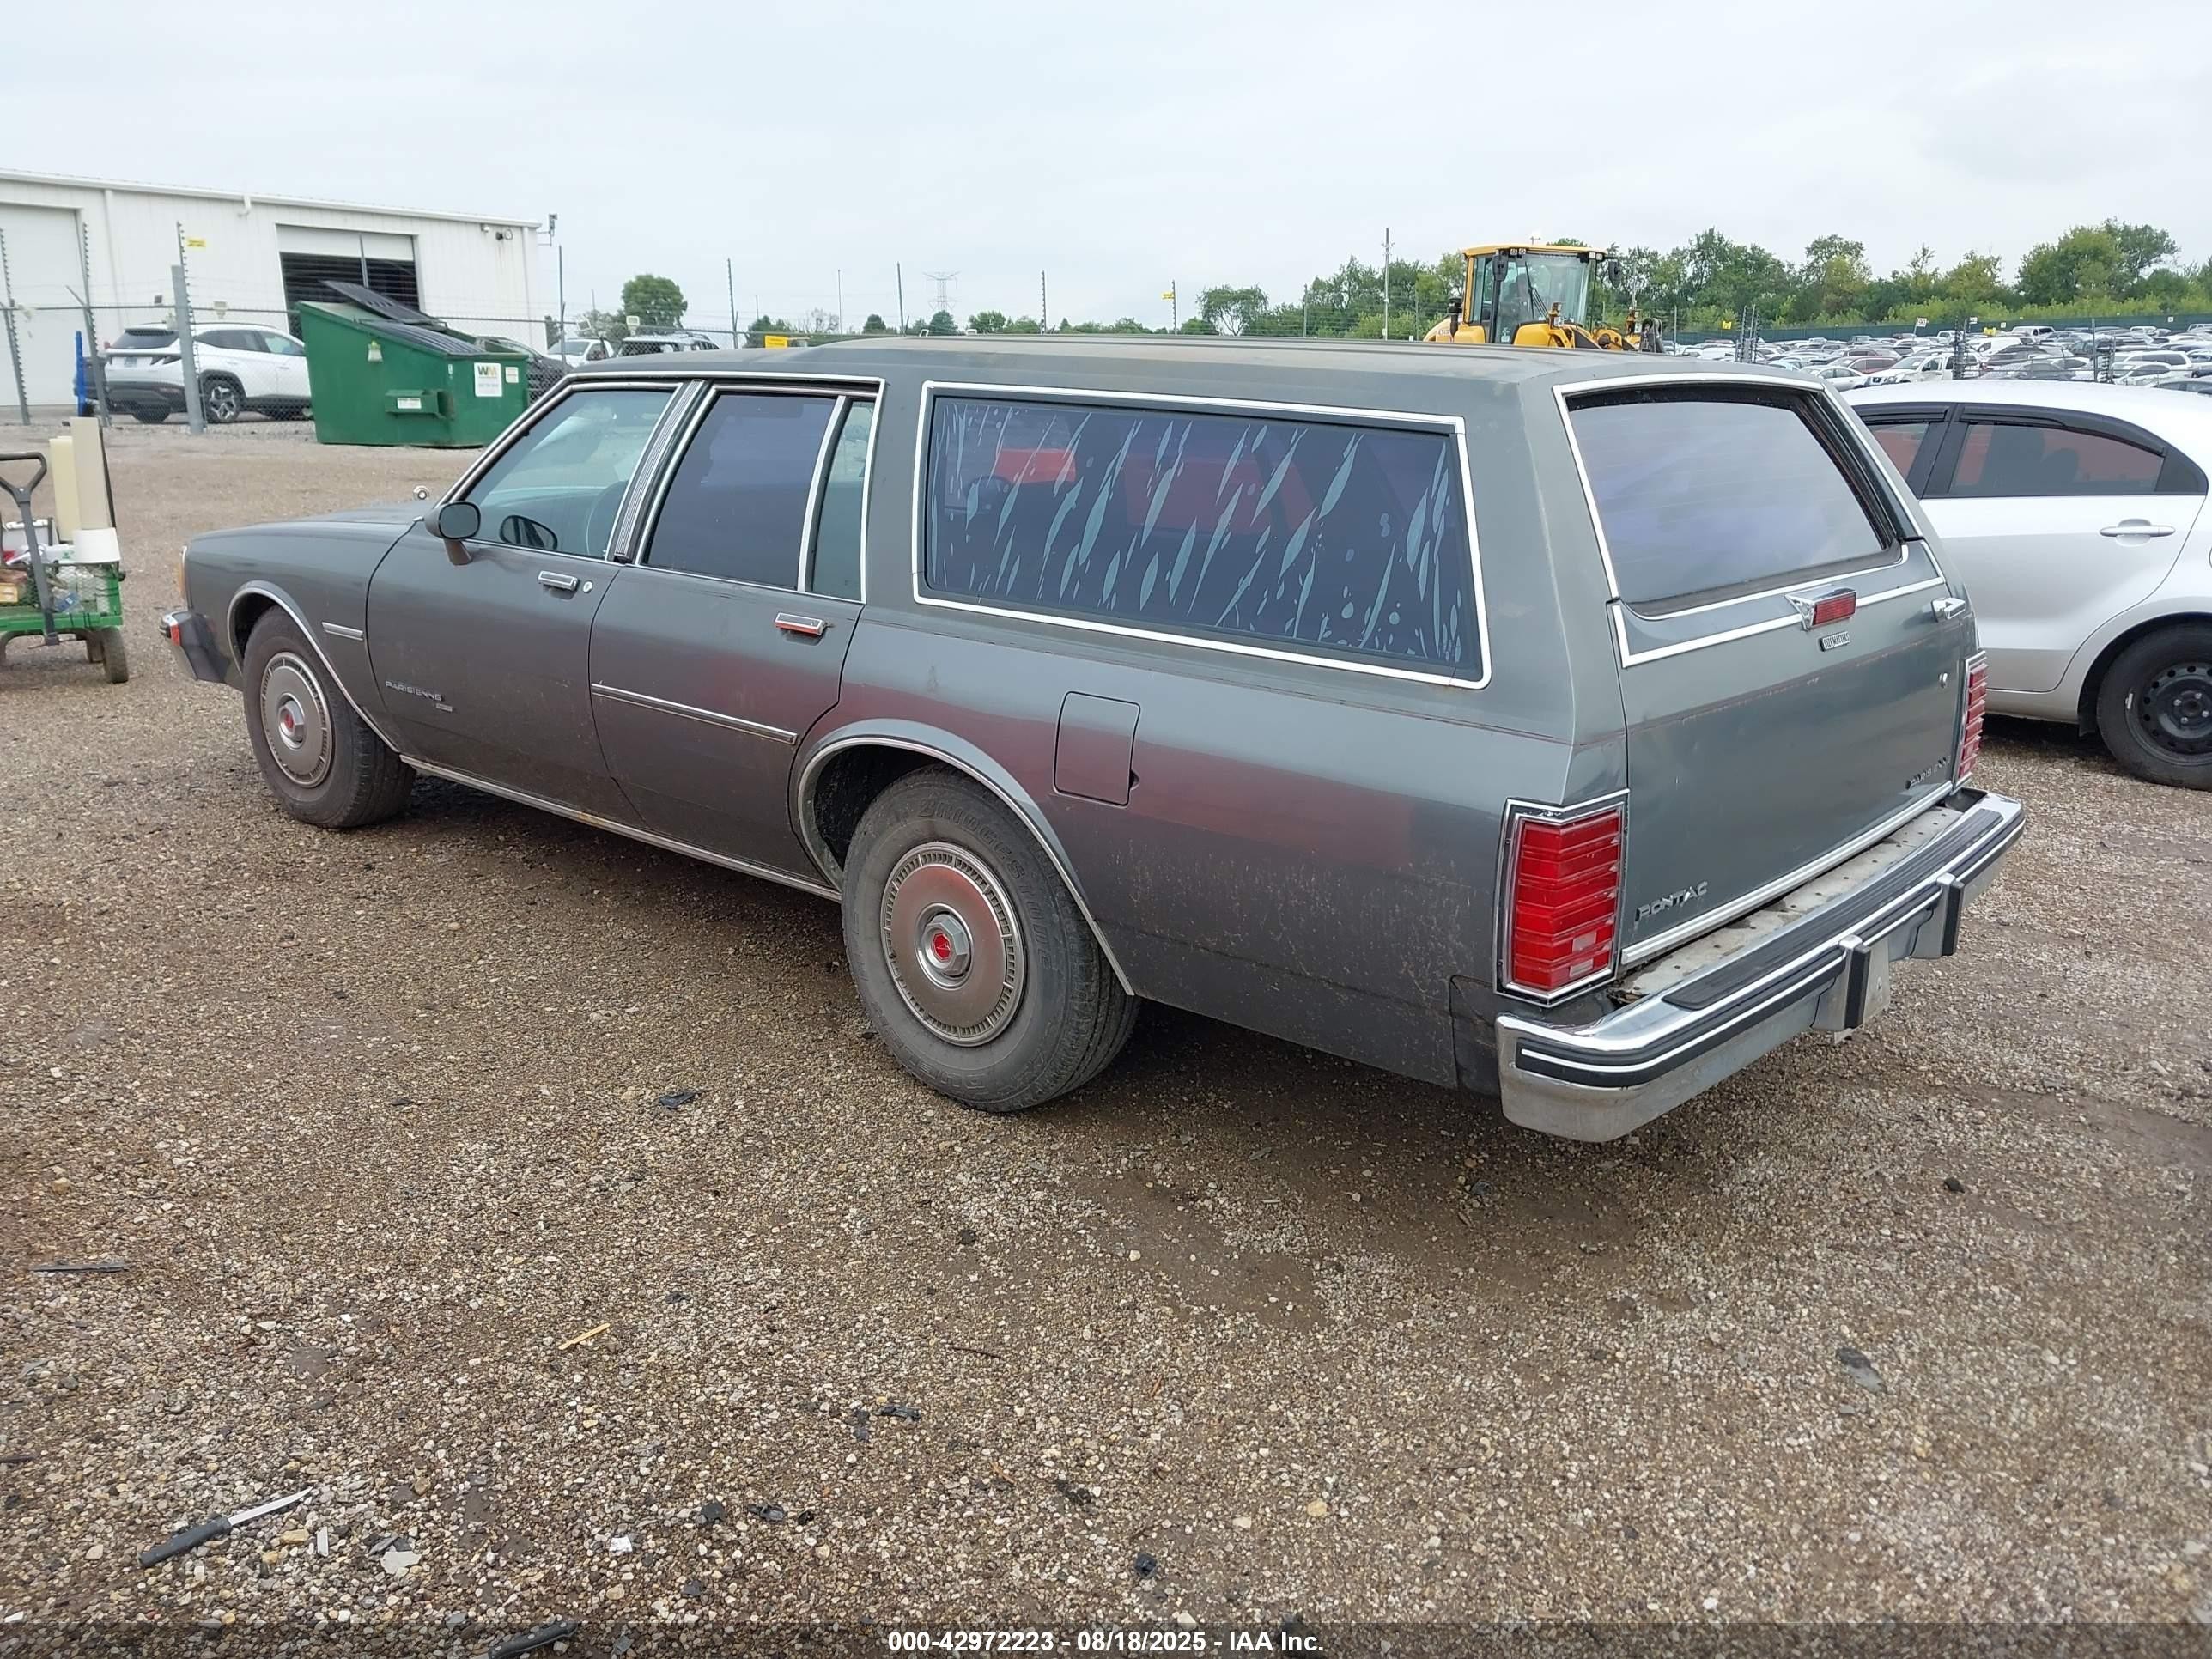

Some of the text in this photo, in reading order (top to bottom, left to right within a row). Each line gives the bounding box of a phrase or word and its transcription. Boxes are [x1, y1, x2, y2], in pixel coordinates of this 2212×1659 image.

[386, 680, 442, 701] PARISIENNE
[1910, 756, 1951, 790] PARISENNE
[1635, 881, 1708, 921] PONTIAC
